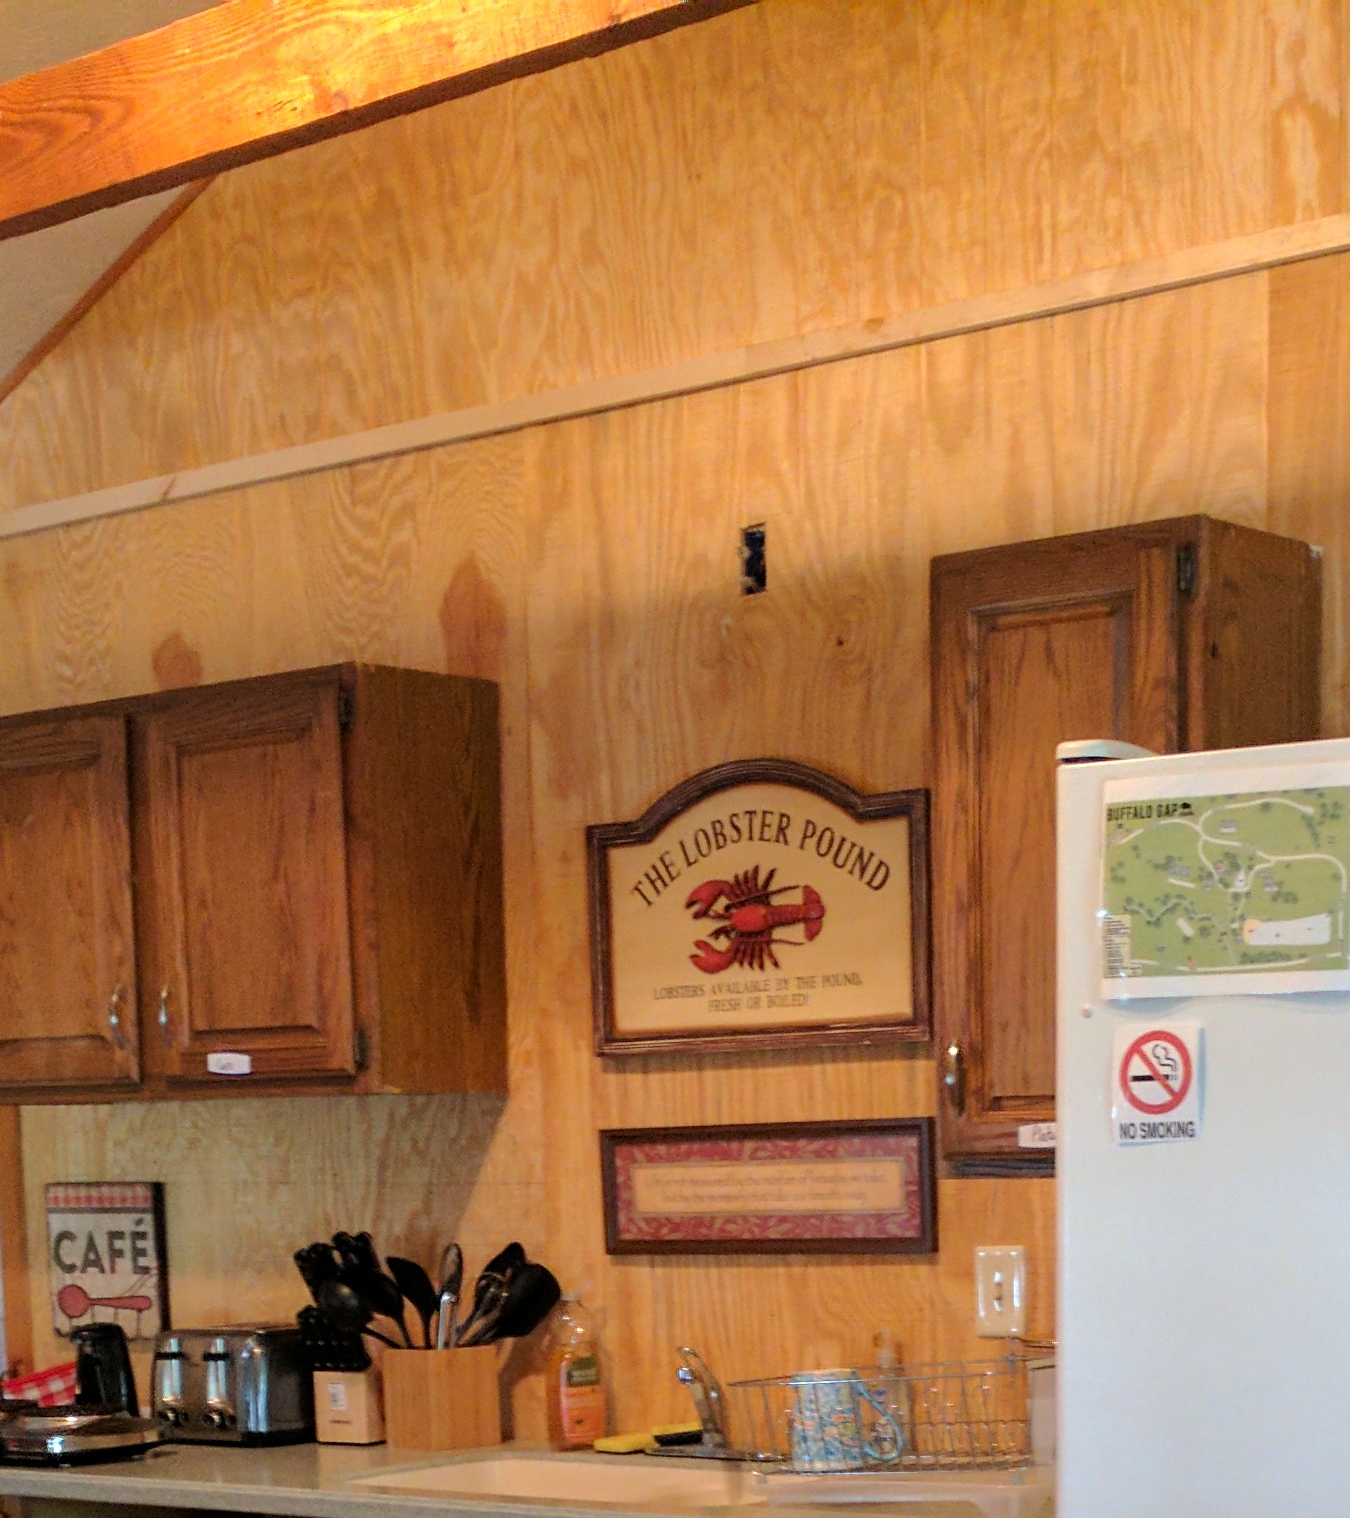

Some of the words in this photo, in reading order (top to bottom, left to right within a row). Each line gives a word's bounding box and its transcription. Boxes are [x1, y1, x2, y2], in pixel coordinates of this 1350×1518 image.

[1106, 804, 1152, 822] BUFFALO
[1157, 802, 1178, 818] GAP
[632, 851, 681, 907] THE
[678, 810, 791, 867] LOBSTER
[798, 819, 891, 892] POUND
[653, 984, 705, 1000] LOBSTERS
[711, 978, 770, 995] AVAILABLE
[776, 976, 789, 991] BY
[794, 975, 817, 989] THE
[708, 998, 741, 1012] FRESH
[747, 996, 761, 1010] OR
[1119, 1122, 1137, 1139] NO
[1139, 1121, 1195, 1139] SMOKING
[53, 1217, 150, 1274] CAFÉ
